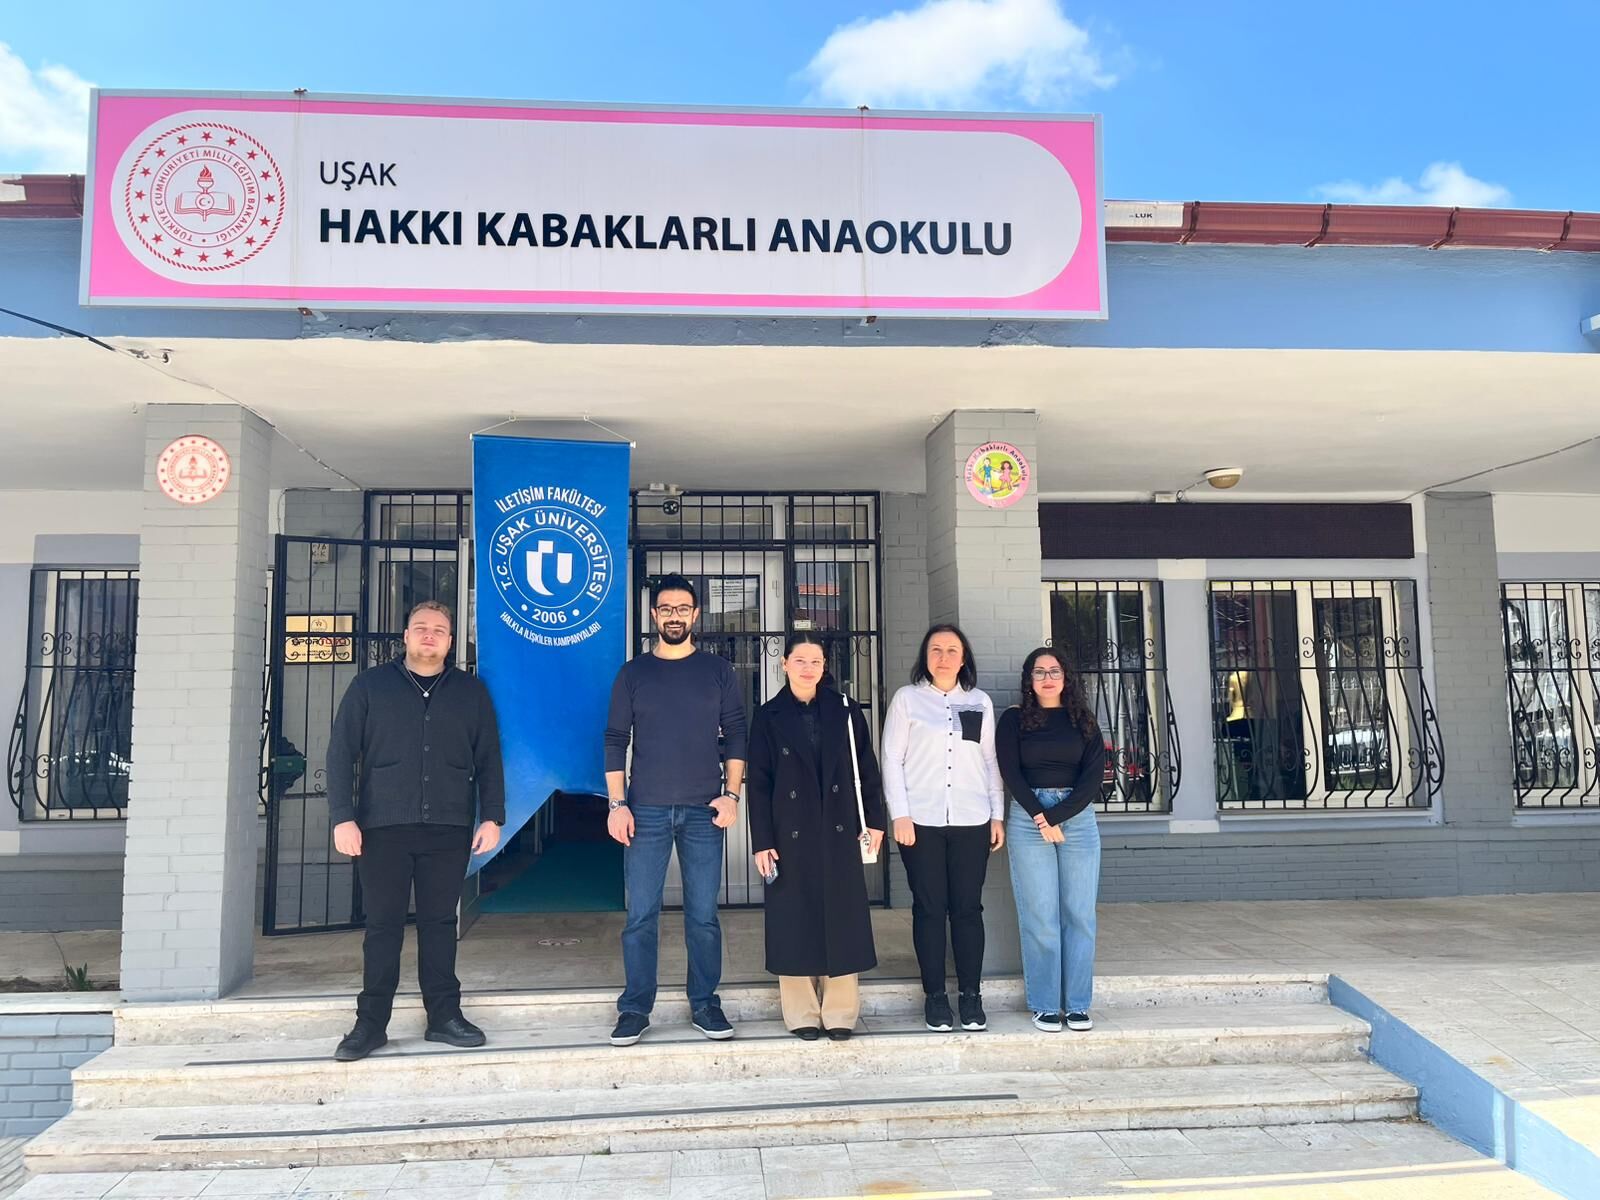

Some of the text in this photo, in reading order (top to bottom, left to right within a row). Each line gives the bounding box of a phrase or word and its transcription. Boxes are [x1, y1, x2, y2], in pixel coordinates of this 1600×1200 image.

[154, 149, 199, 207] CUMHURİYETİ
[202, 149, 232, 164] MİLLİ
[319, 160, 397, 191] UŞAK
[319, 207, 1013, 256] HAKKI KABAKLARLI ANAOKULU
[973, 444, 1008, 459] baklarlı
[494, 485, 607, 519] İLETİŞİM FAKÜLTESİ
[495, 509, 609, 601] T.C. UŞAK ÜNİVERSİTESİ
[531, 608, 567, 624] 2006
